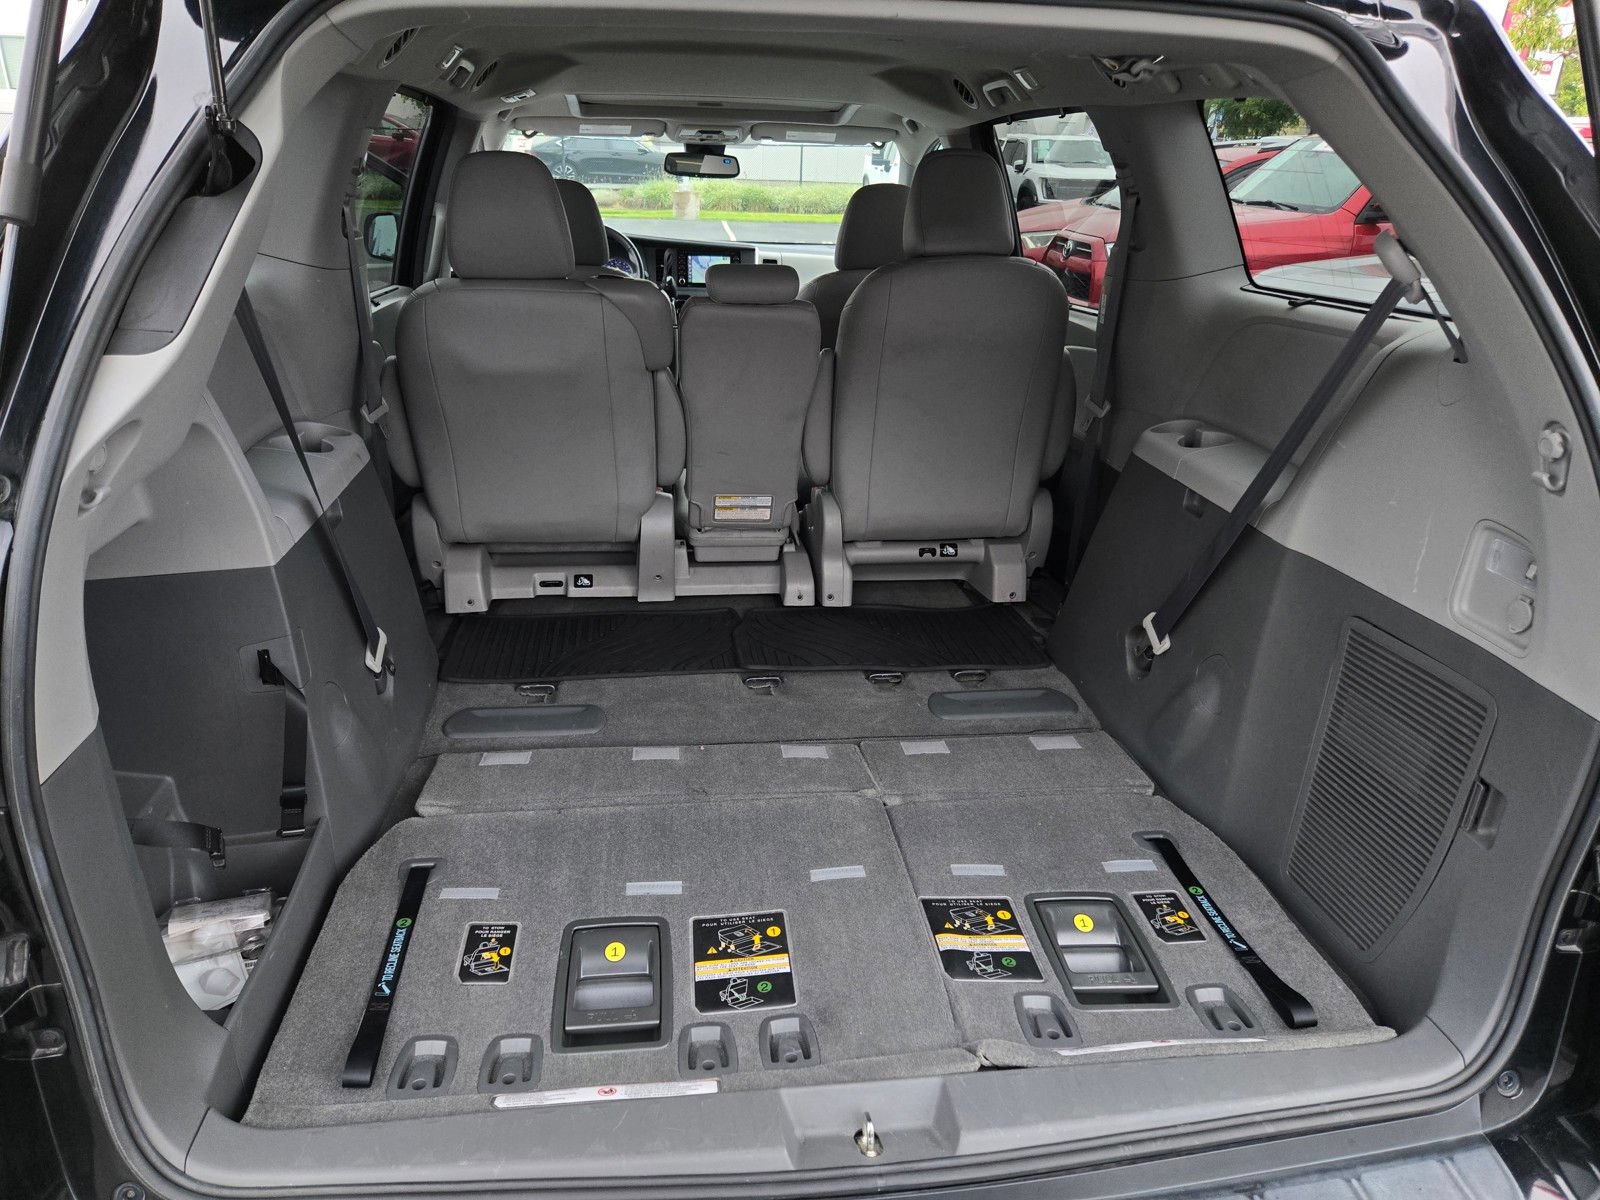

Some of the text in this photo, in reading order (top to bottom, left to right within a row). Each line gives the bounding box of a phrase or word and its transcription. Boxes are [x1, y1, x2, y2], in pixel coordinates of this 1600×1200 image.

[1196, 895, 1218, 917] SEATBACK
[1080, 918, 1089, 928] 1
[1211, 915, 1232, 934] RECLINE
[390, 928, 407, 953] SEATBACK
[611, 947, 620, 957] 1
[384, 953, 400, 974] RECLINE
